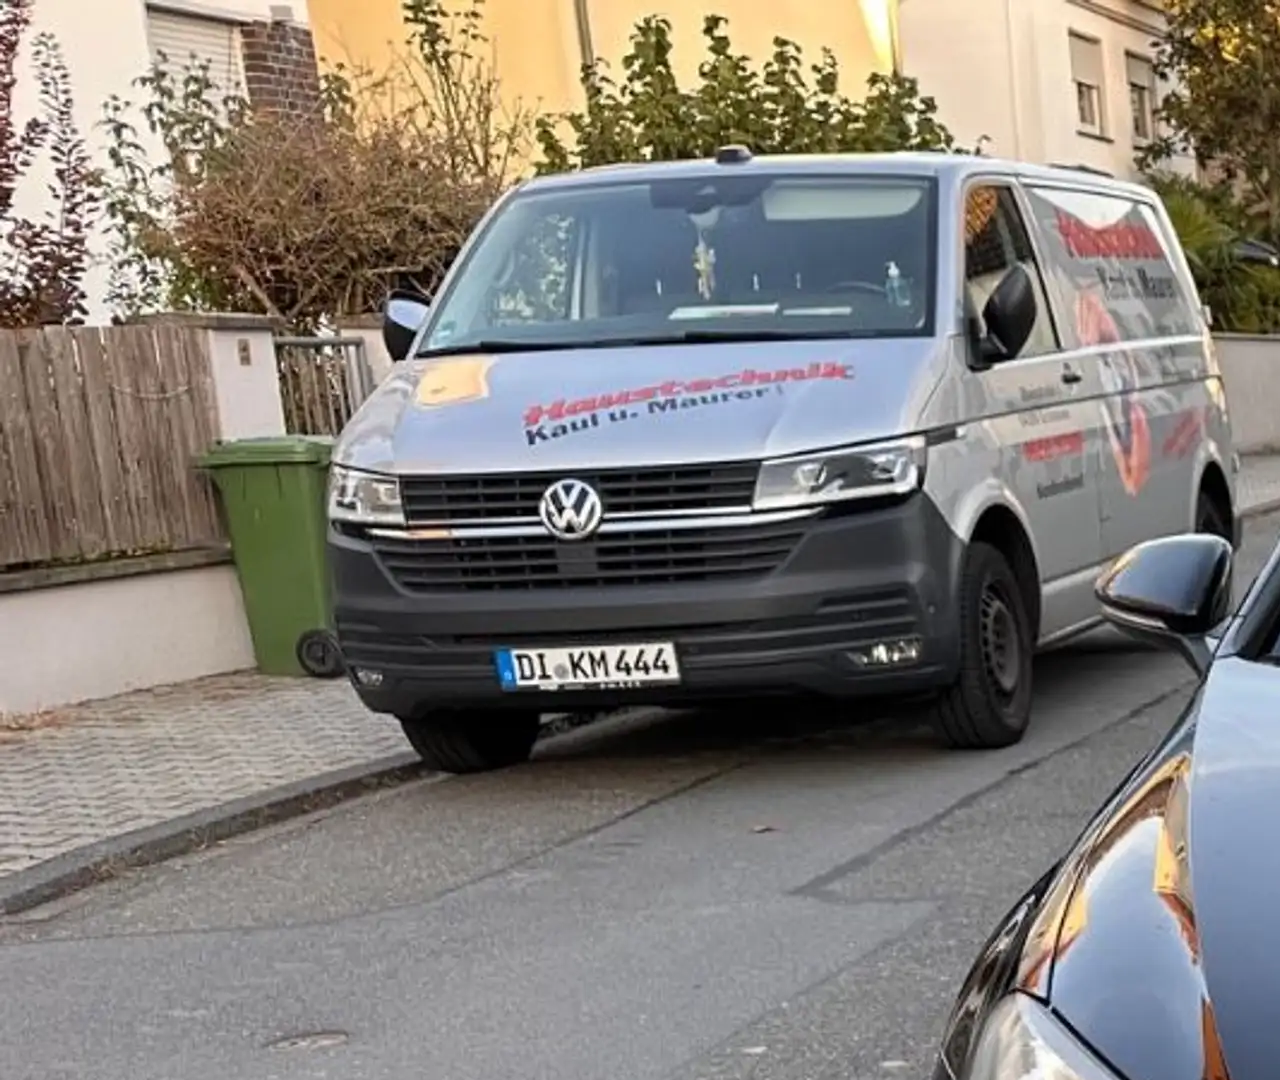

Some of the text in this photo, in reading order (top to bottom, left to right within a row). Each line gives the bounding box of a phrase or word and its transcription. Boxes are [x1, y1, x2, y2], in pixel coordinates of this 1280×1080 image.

[523, 361, 856, 427] Haustechnik
[609, 408, 639, 423] u.
[647, 385, 773, 415] Maurer
[514, 652, 554, 681] DI
